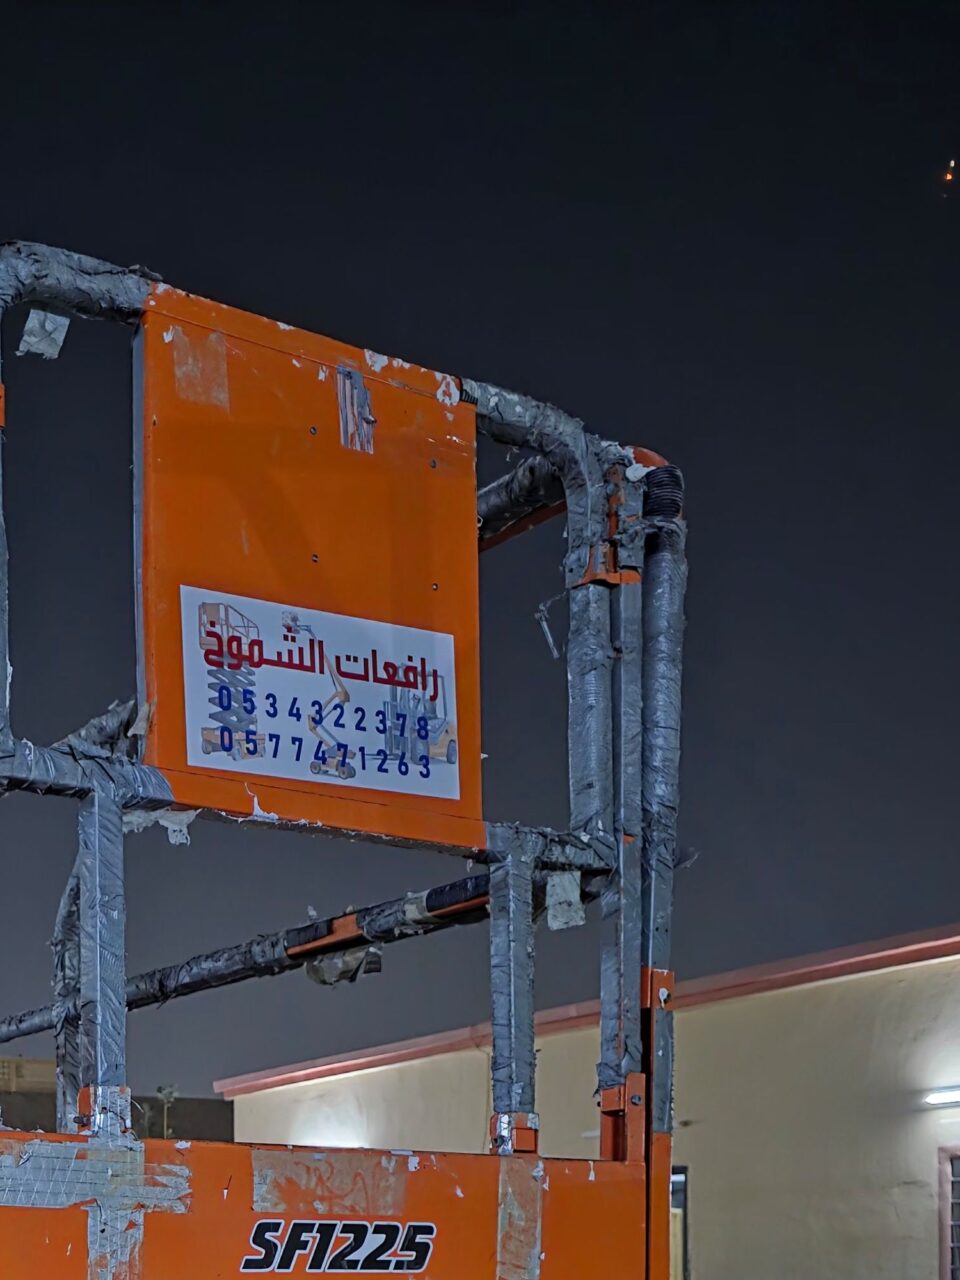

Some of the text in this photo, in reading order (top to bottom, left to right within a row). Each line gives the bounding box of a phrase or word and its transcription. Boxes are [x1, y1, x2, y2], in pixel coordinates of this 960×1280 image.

[203, 620, 439, 701] رافعات الشموخ
[240, 1219, 437, 1273] SF1225
